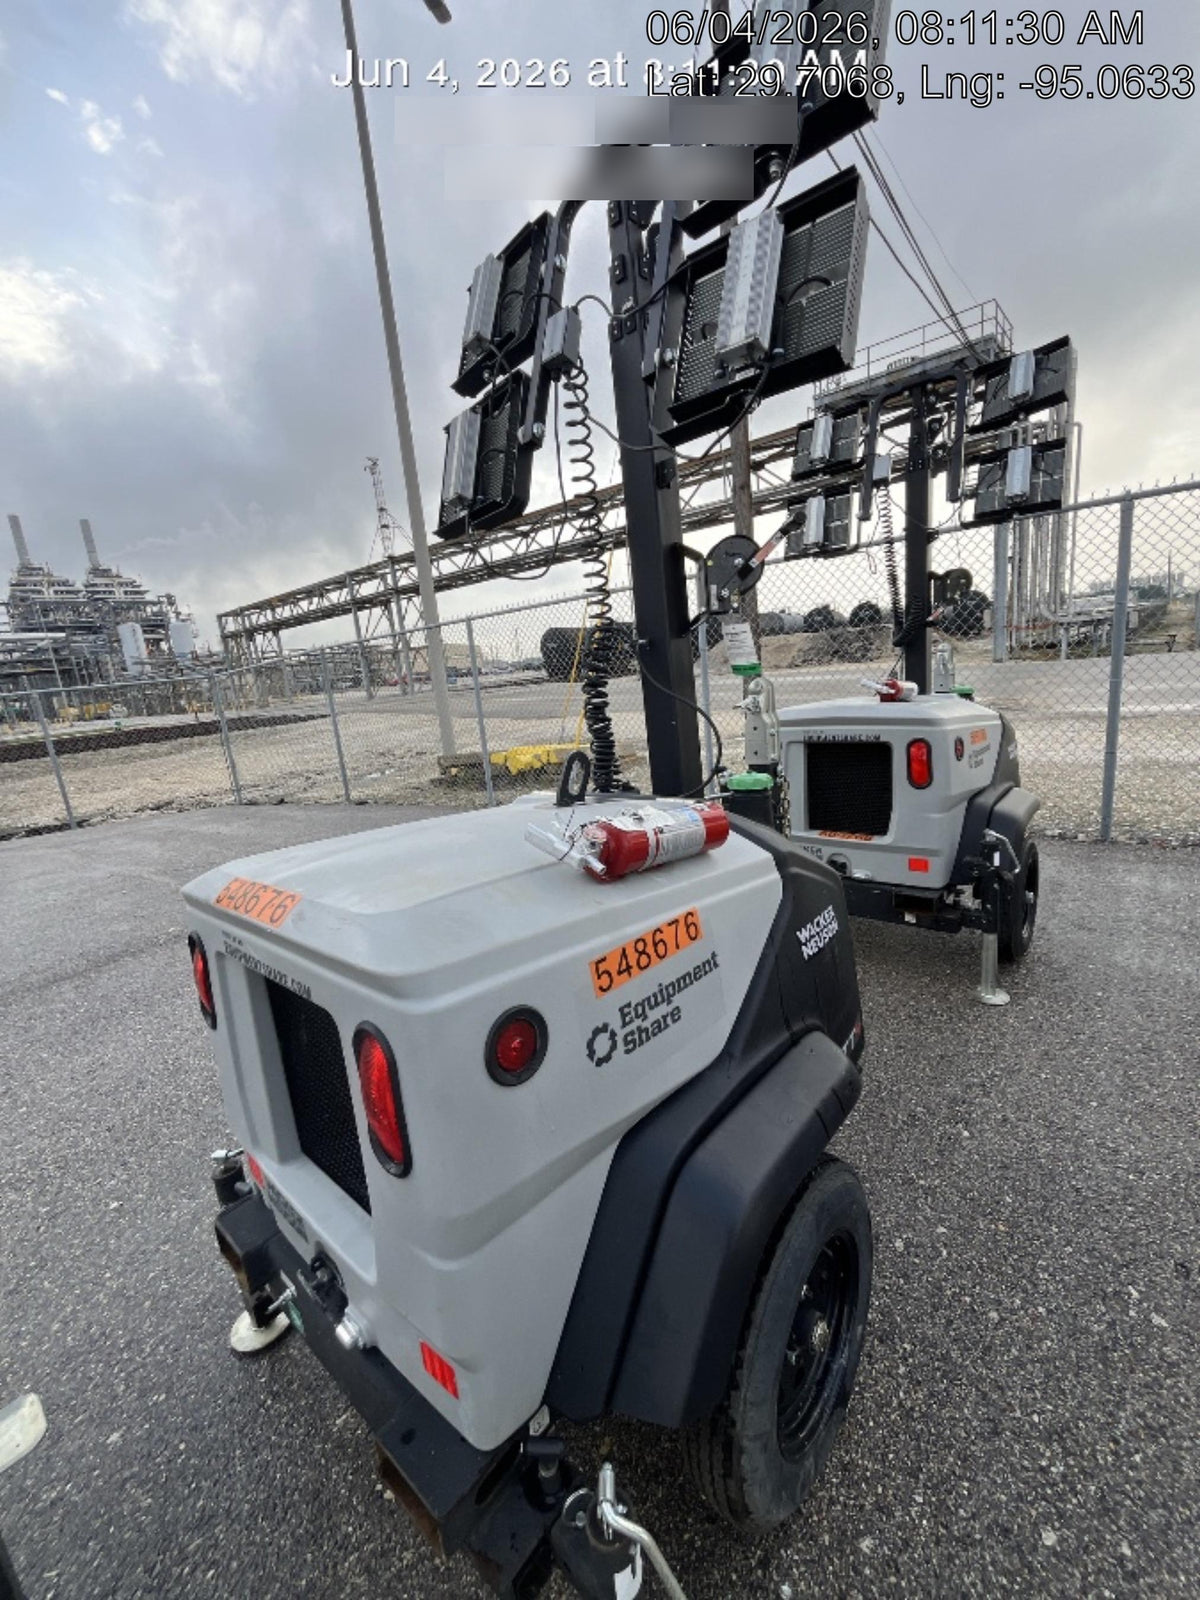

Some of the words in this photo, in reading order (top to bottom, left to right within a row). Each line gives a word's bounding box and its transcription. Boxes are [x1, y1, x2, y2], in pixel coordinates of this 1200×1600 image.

[796, 904, 835, 944] WACKER
[801, 918, 839, 961] NEUSON
[594, 911, 699, 993] 548676
[618, 951, 721, 1030] Equipment
[622, 1005, 683, 1055] Share
